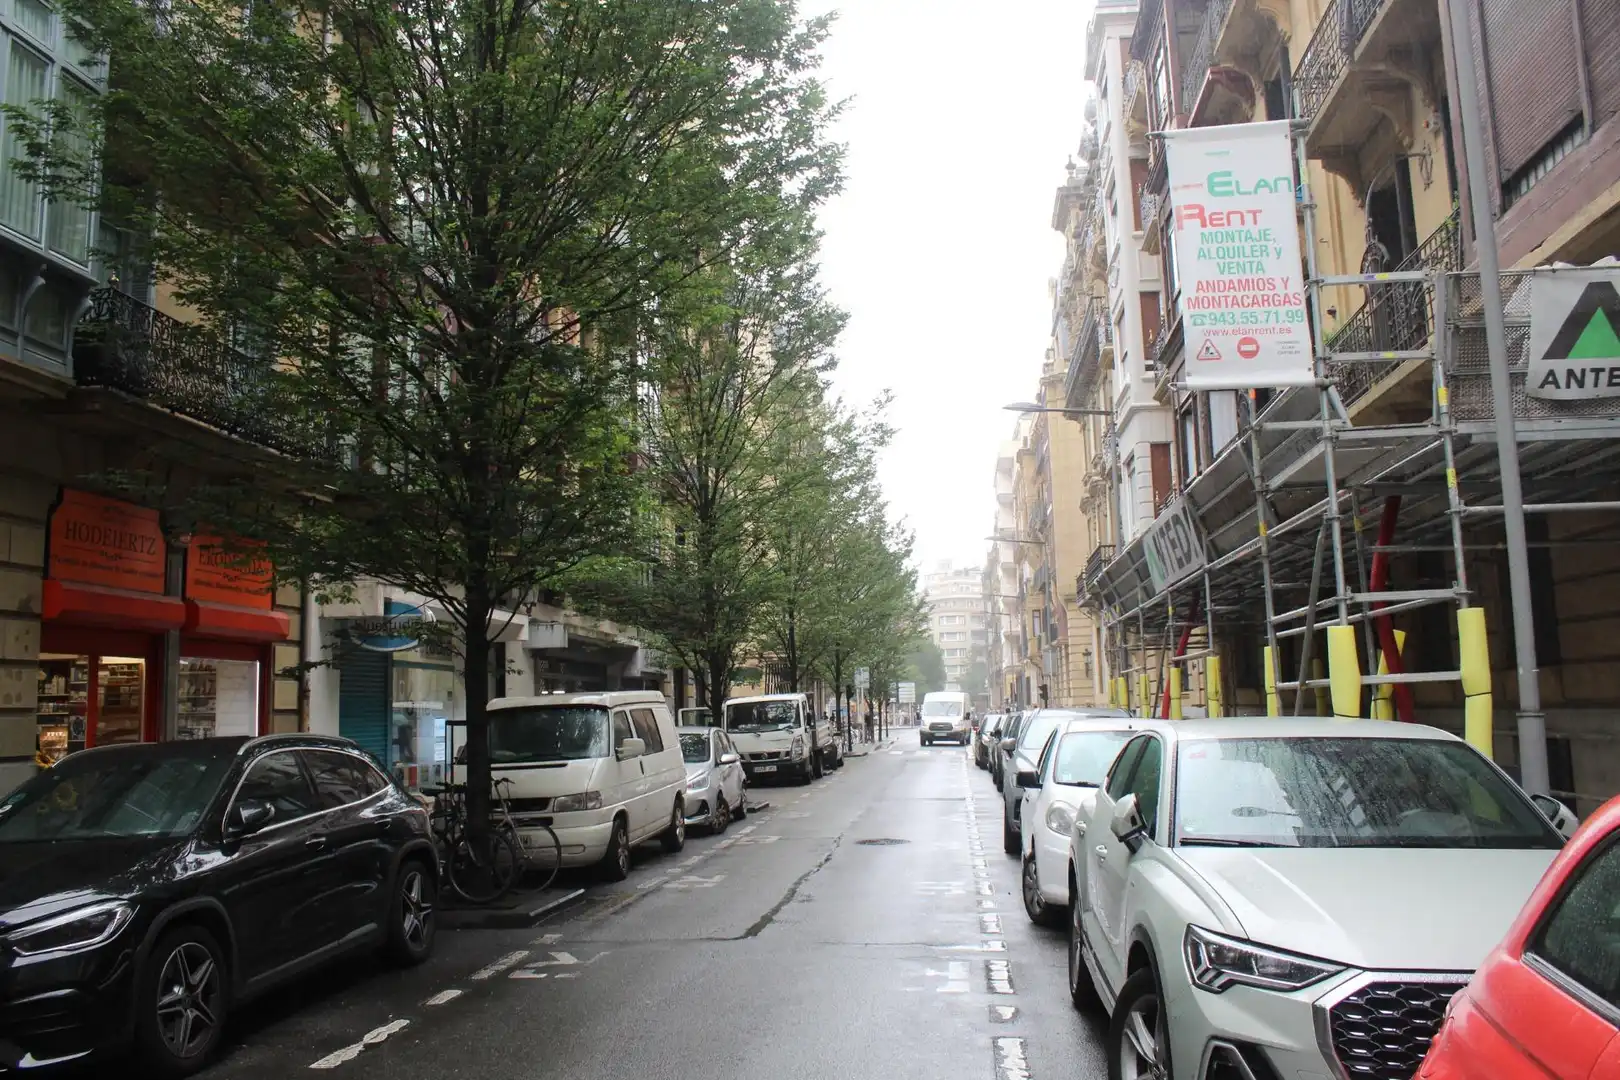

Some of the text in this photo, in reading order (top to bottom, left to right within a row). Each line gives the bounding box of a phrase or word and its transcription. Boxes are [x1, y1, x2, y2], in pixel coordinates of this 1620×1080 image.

[1200, 228, 1276, 244] MONTAJE,
[1197, 245, 1270, 260] ALQUILER
[1217, 261, 1265, 275] VENTA
[1196, 276, 1290, 293] ANDAMIOS Y
[1187, 292, 1302, 310] MONTACARGAS
[1208, 309, 1305, 326] 943.55.71.99
[1203, 326, 1292, 337] www.elanrent.es
[64, 519, 157, 556] HODEIERTZ
